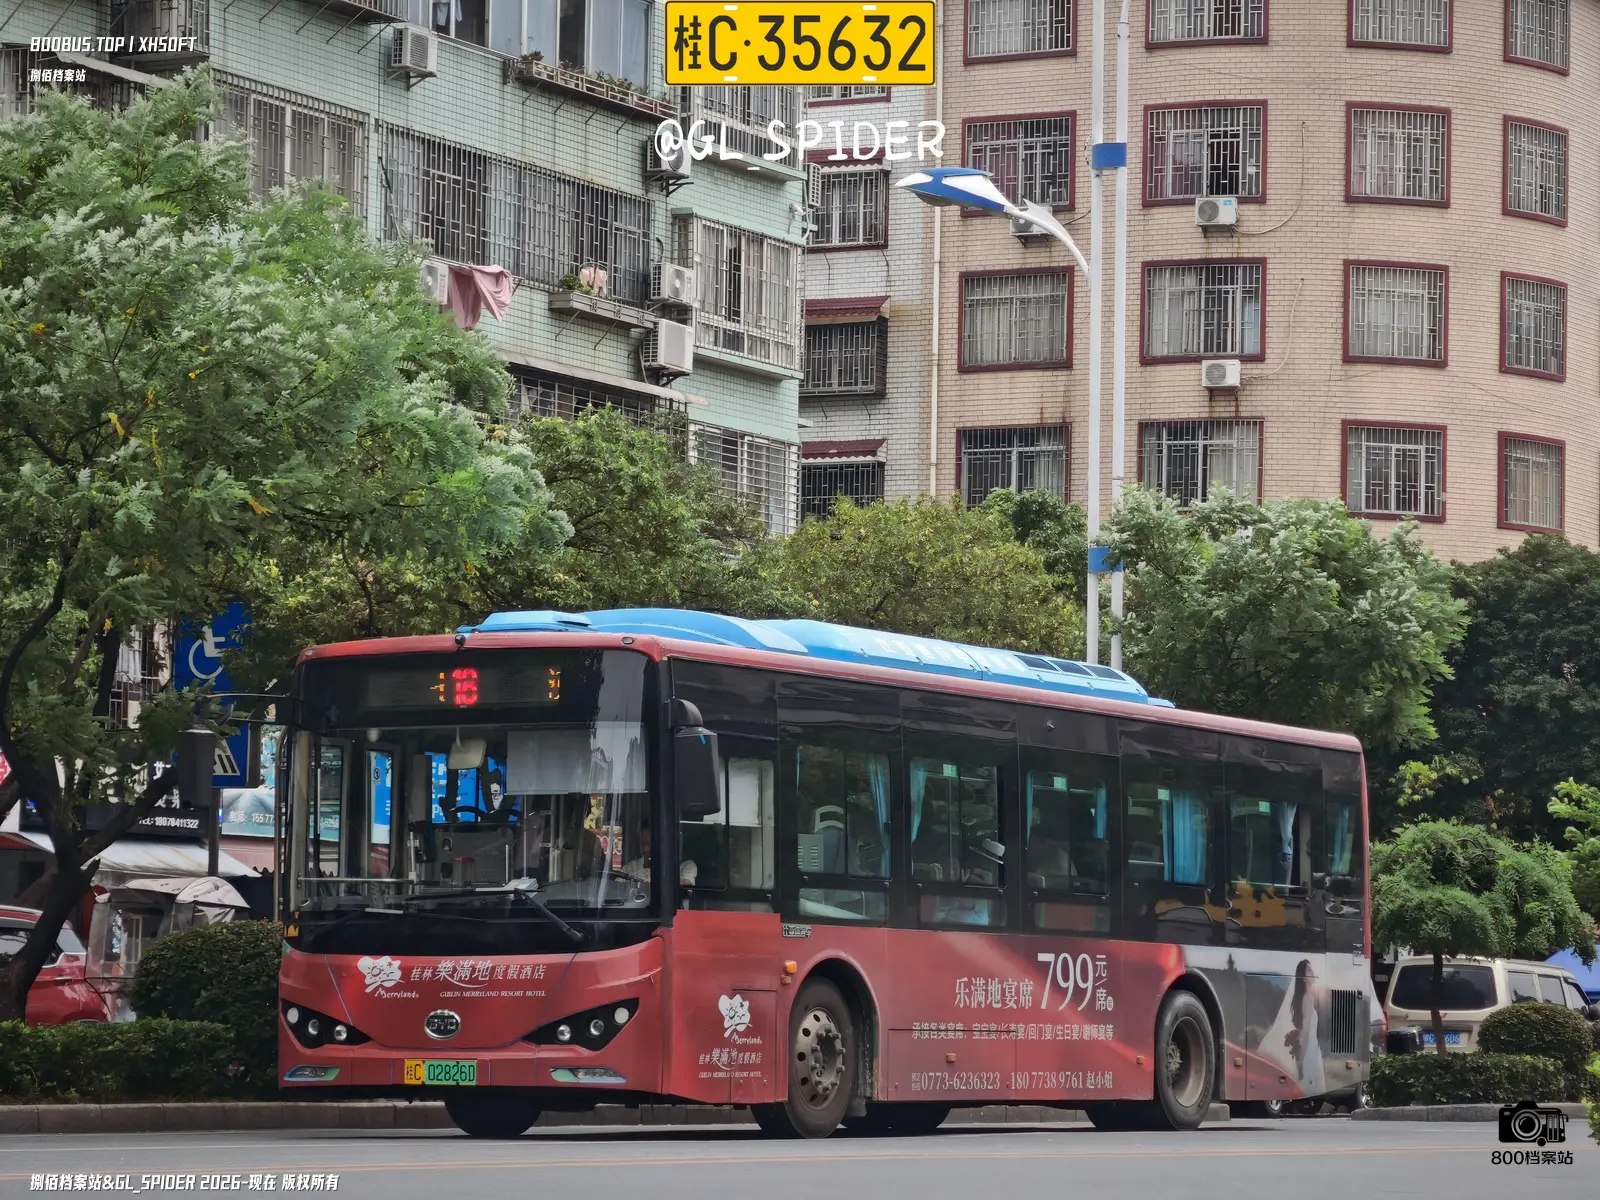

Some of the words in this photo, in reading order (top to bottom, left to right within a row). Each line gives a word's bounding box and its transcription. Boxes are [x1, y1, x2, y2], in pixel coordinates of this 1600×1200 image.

[954, 976, 1034, 1010] 乐满地宴席
[1037, 952, 1094, 1012] 799
[440, 990, 461, 998] GUILIN
[462, 990, 499, 998] MERRYLAND
[501, 990, 524, 998] RESORT
[526, 990, 546, 998] HOTEL
[921, 1071, 1000, 1090] 0773-6236323
[1010, 1071, 1029, 1089] 180
[1032, 1071, 1057, 1089] 7738
[1059, 1071, 1083, 1089] 9761
[1086, 1071, 1113, 1089] 赵小姐
